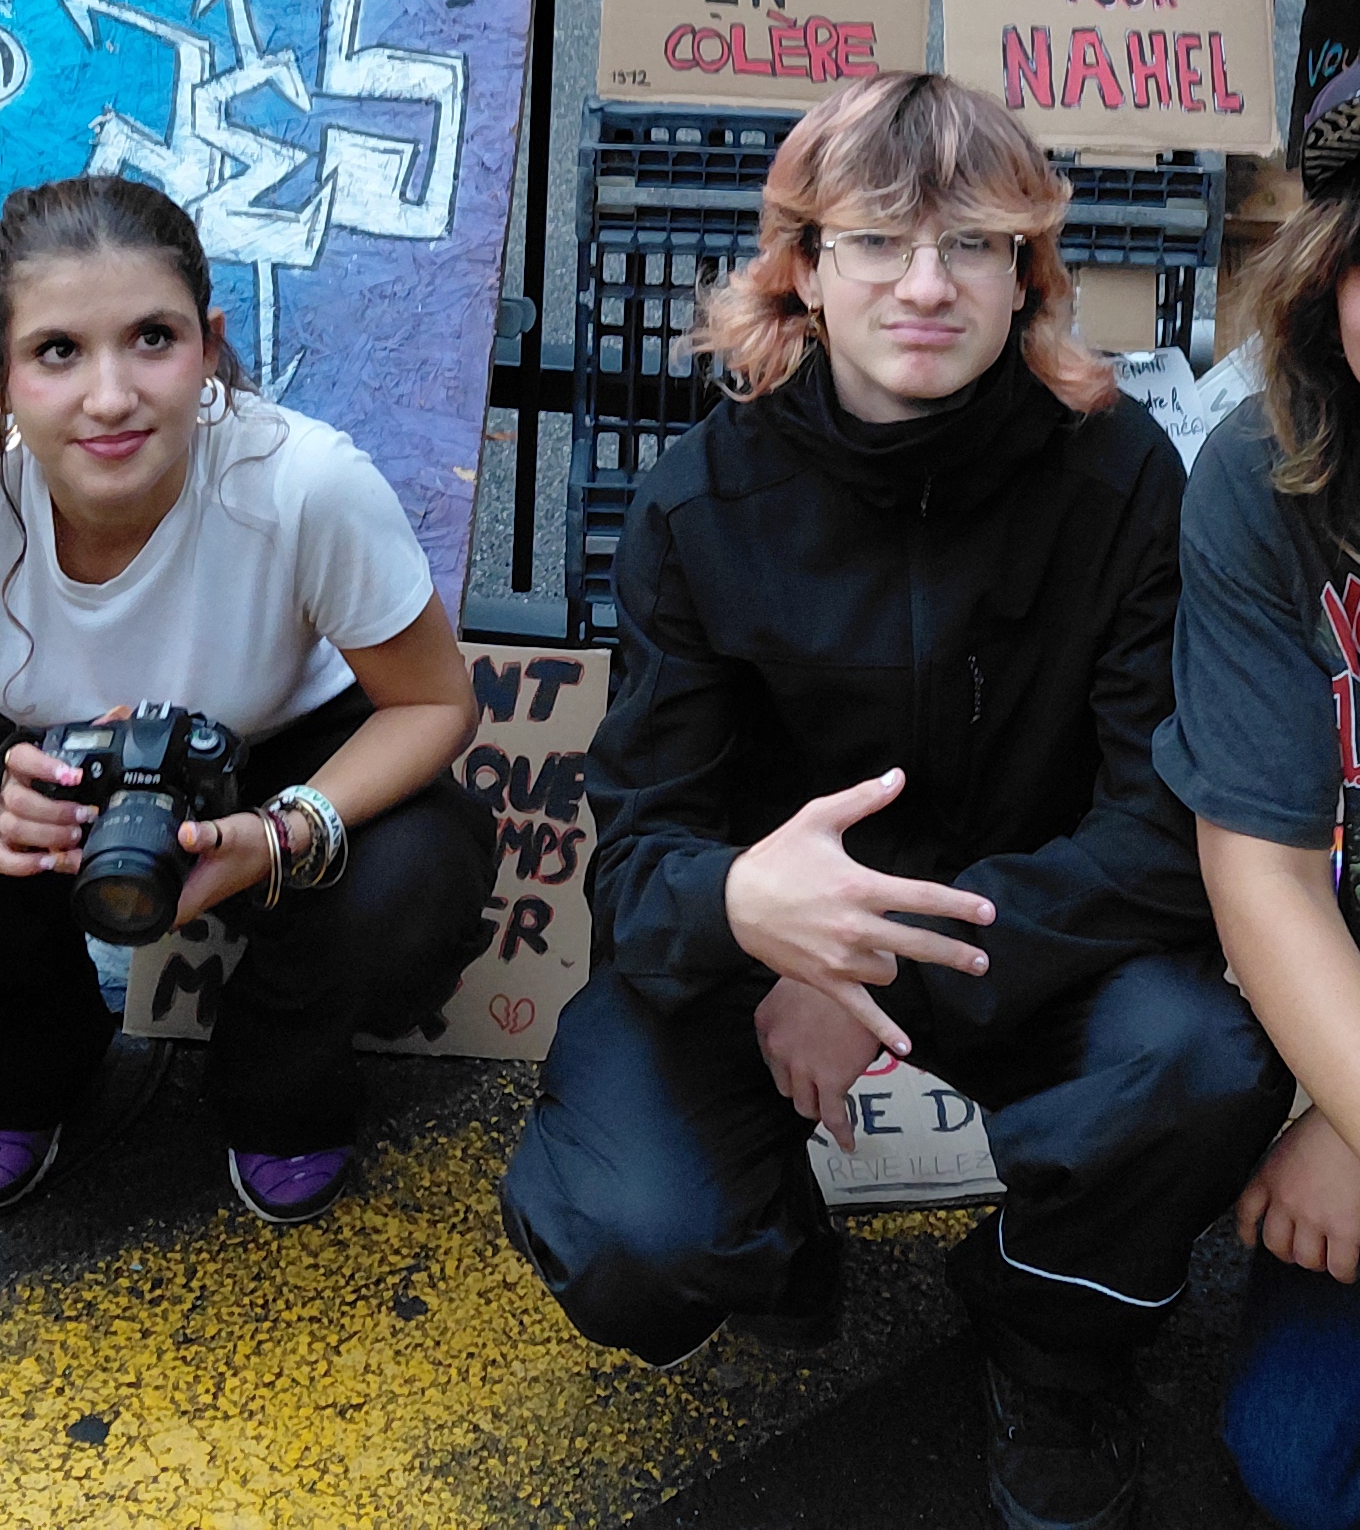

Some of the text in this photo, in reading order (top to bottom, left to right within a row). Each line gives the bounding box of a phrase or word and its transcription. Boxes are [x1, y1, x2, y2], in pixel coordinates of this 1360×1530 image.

[663, 9, 881, 84] COLÈRE
[1001, 24, 1246, 114] NAHEL
[123, 771, 161, 786] Nikon
